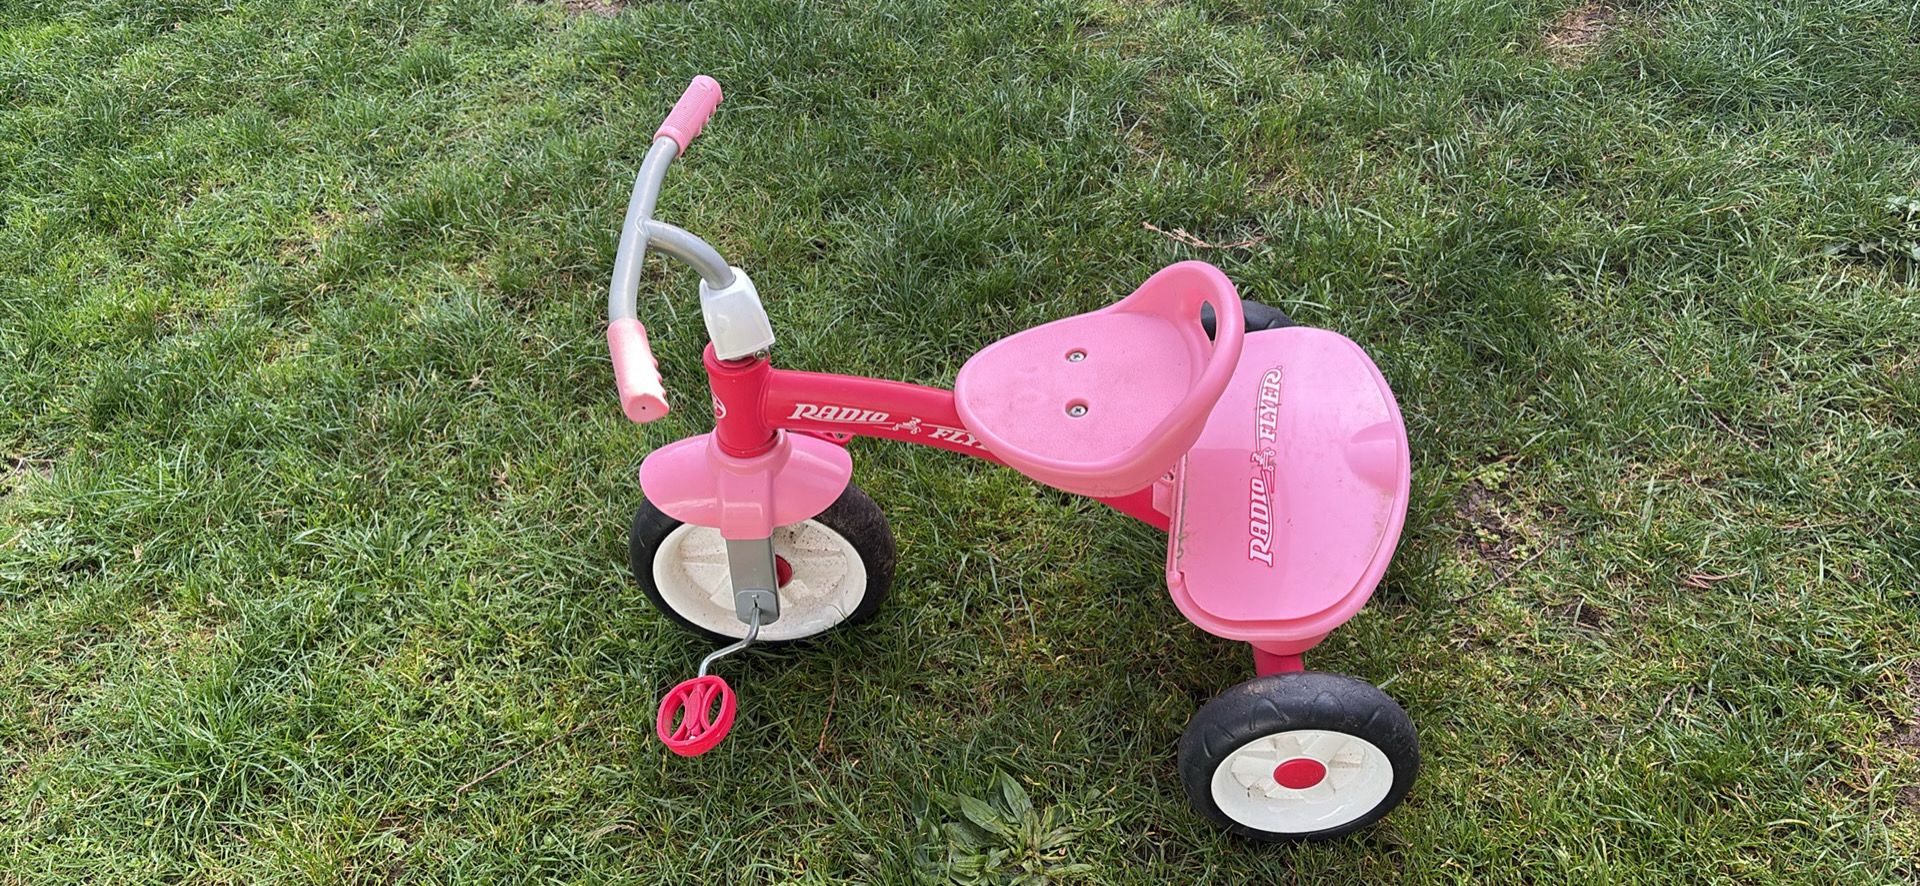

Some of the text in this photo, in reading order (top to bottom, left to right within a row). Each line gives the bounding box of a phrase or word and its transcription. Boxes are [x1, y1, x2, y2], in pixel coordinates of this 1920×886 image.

[787, 403, 989, 452] RADIO FLY
[1250, 367, 1283, 567] RADIO FLYER
